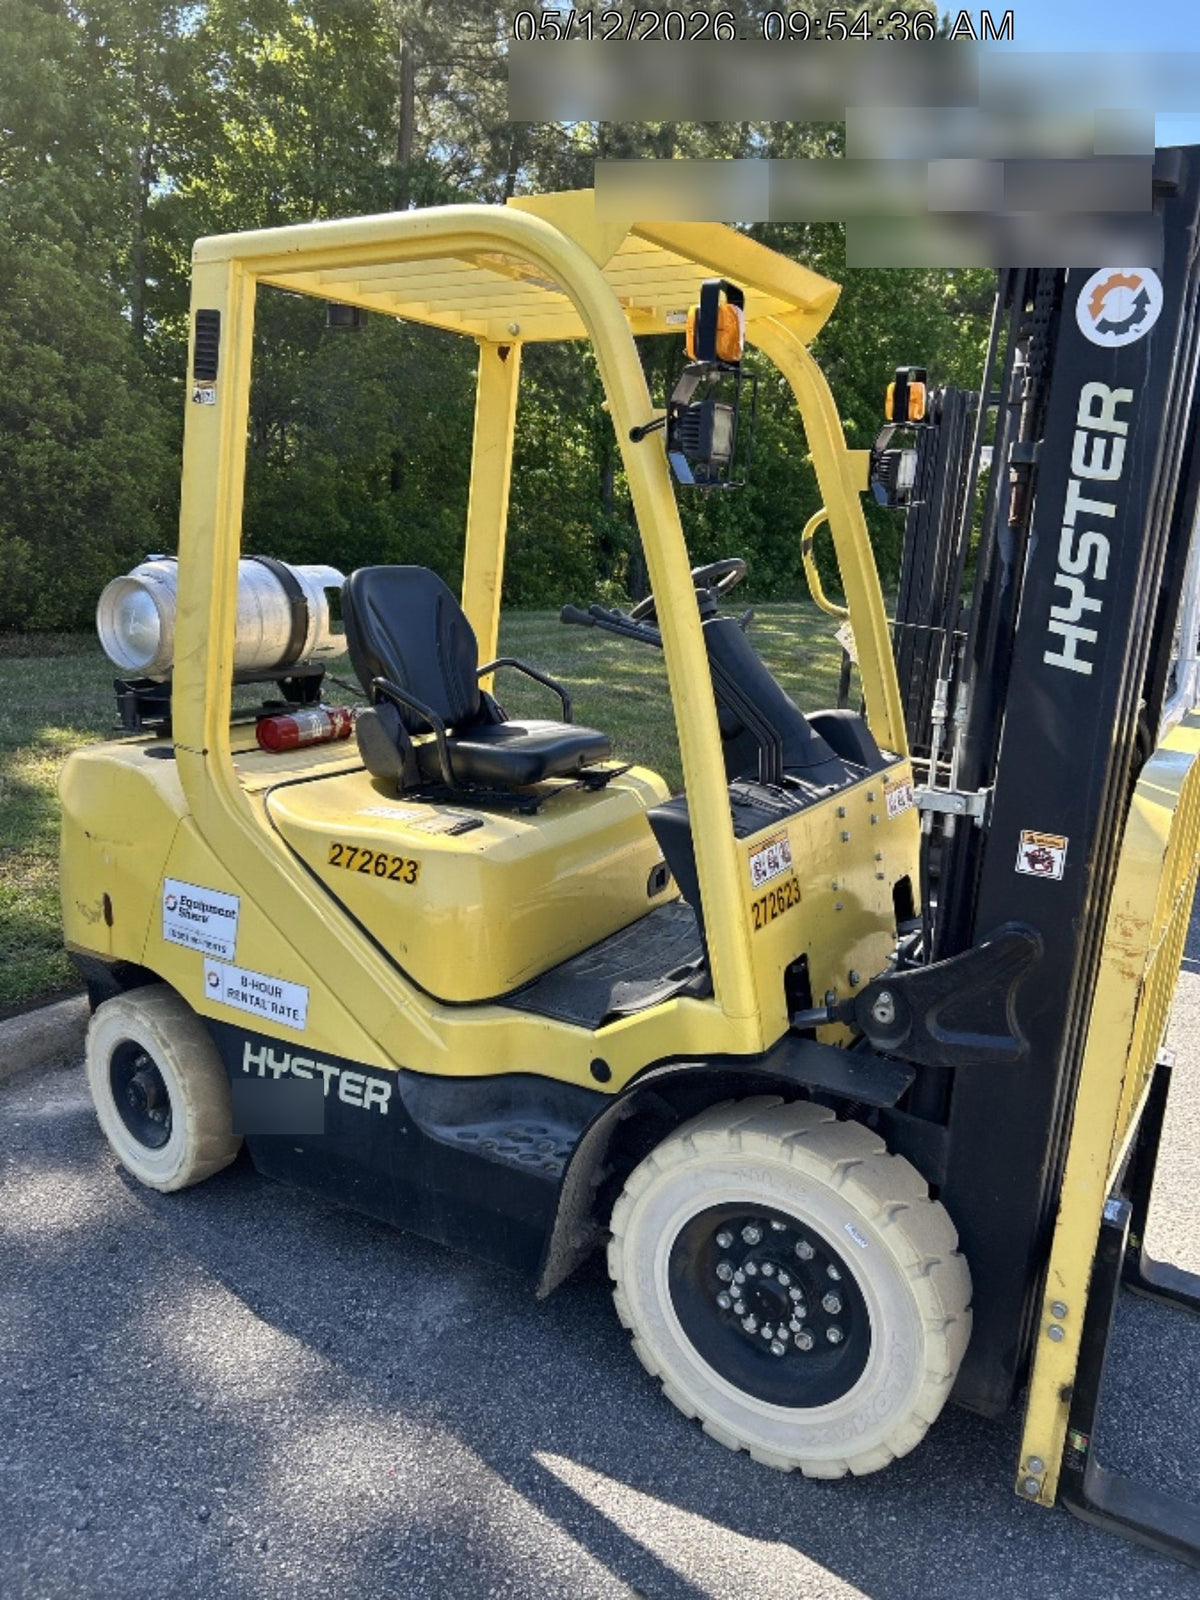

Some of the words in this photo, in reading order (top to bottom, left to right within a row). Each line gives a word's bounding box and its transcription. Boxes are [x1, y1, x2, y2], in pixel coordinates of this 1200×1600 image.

[1043, 381, 1134, 675] HYSTER
[328, 843, 420, 884] 272623
[751, 877, 801, 932] 272623
[226, 987, 268, 1011] RENTAL
[270, 1002, 301, 1022] RATE
[240, 975, 283, 999] 8-HOUR
[242, 1041, 392, 1115] HYSTER
